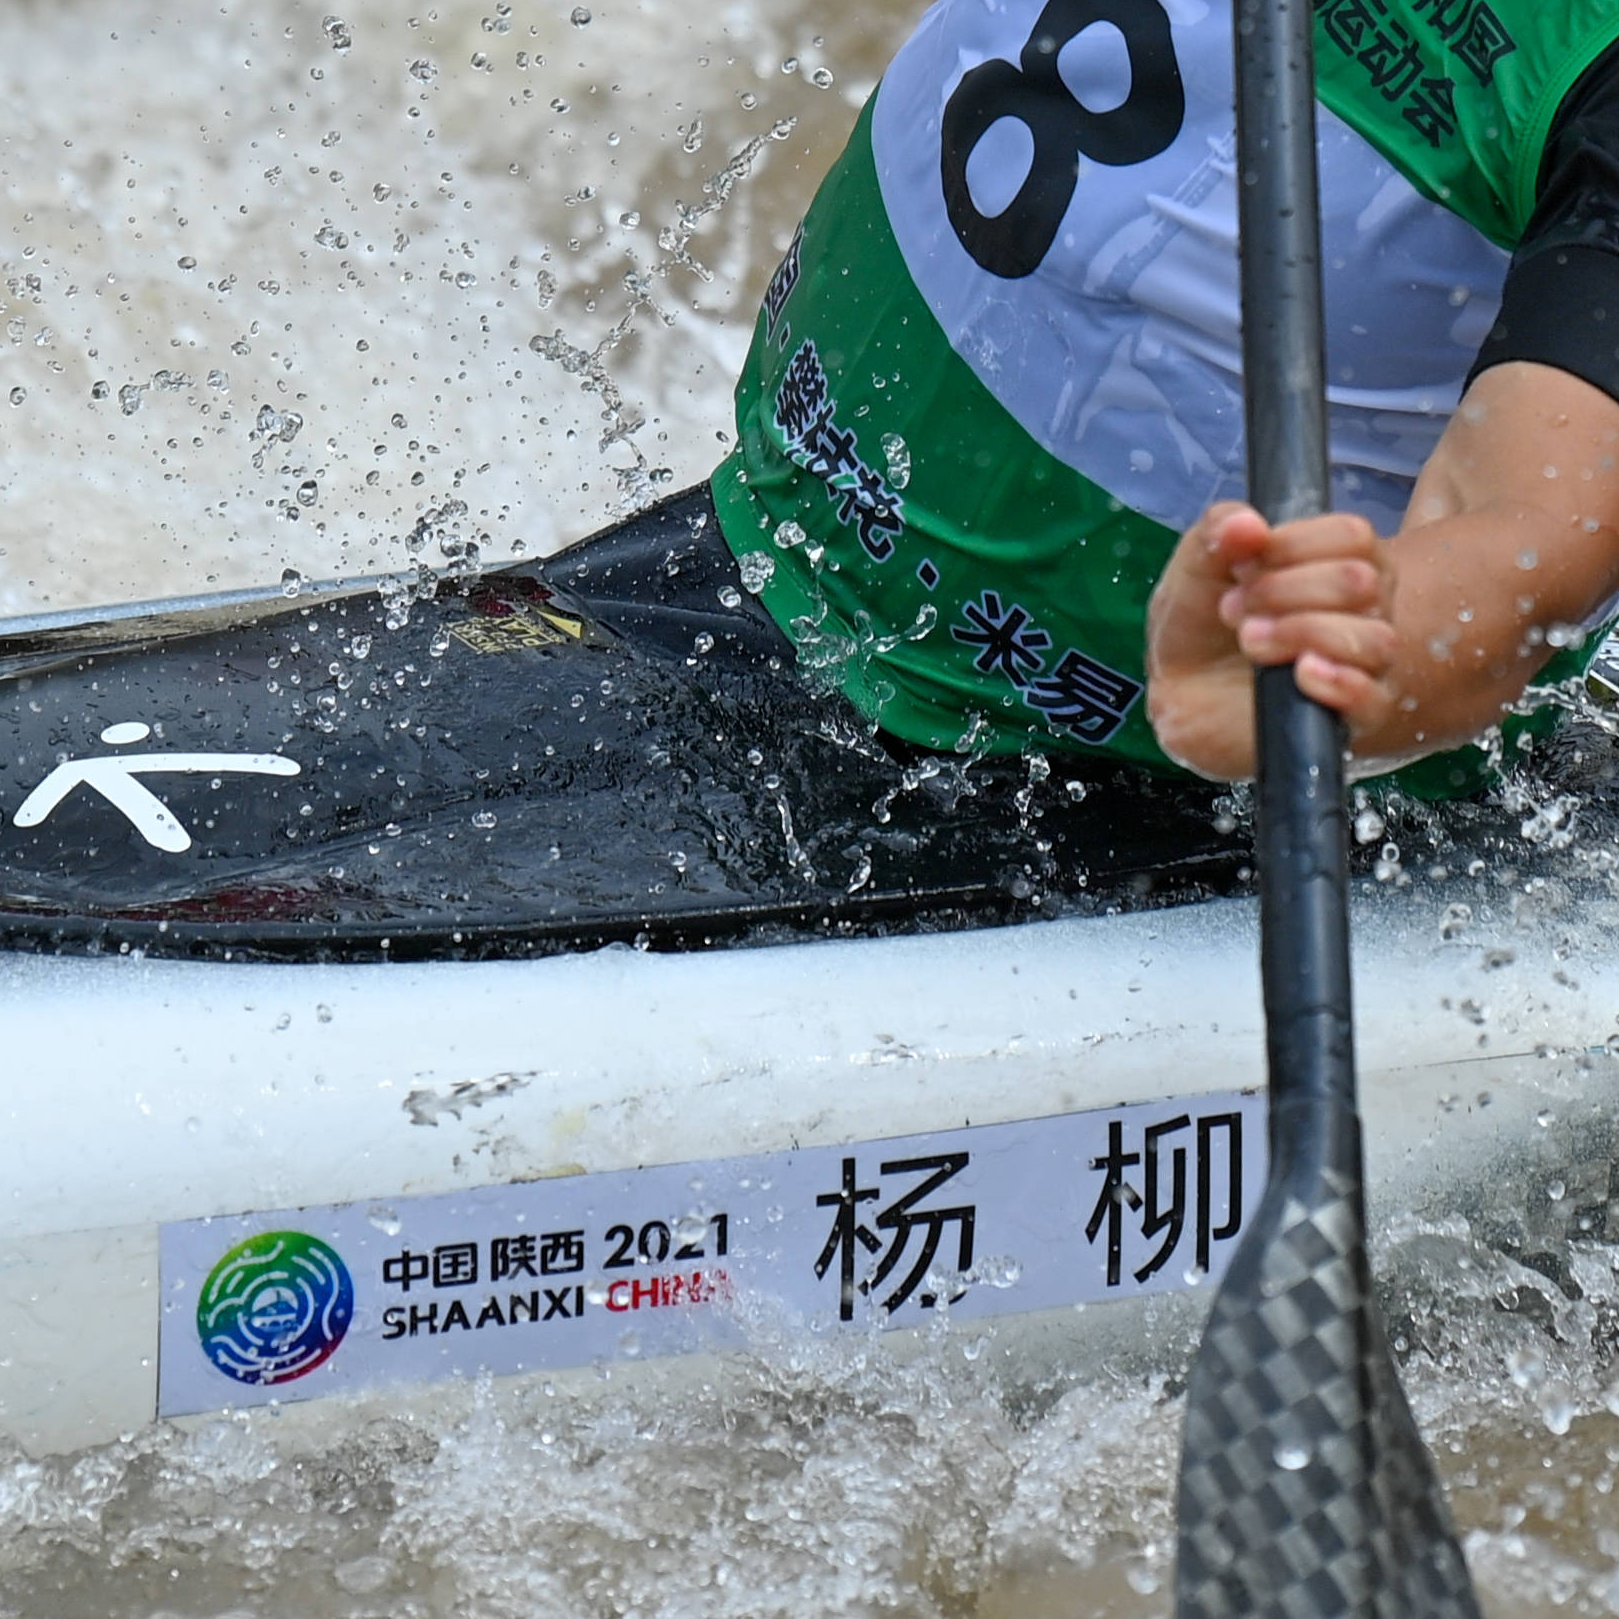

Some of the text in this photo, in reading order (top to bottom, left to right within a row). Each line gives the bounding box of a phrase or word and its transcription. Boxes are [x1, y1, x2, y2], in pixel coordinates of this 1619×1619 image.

[382, 1213, 729, 1292] 中国 陕西 2021
[382, 1285, 585, 1340] SHAANXI
